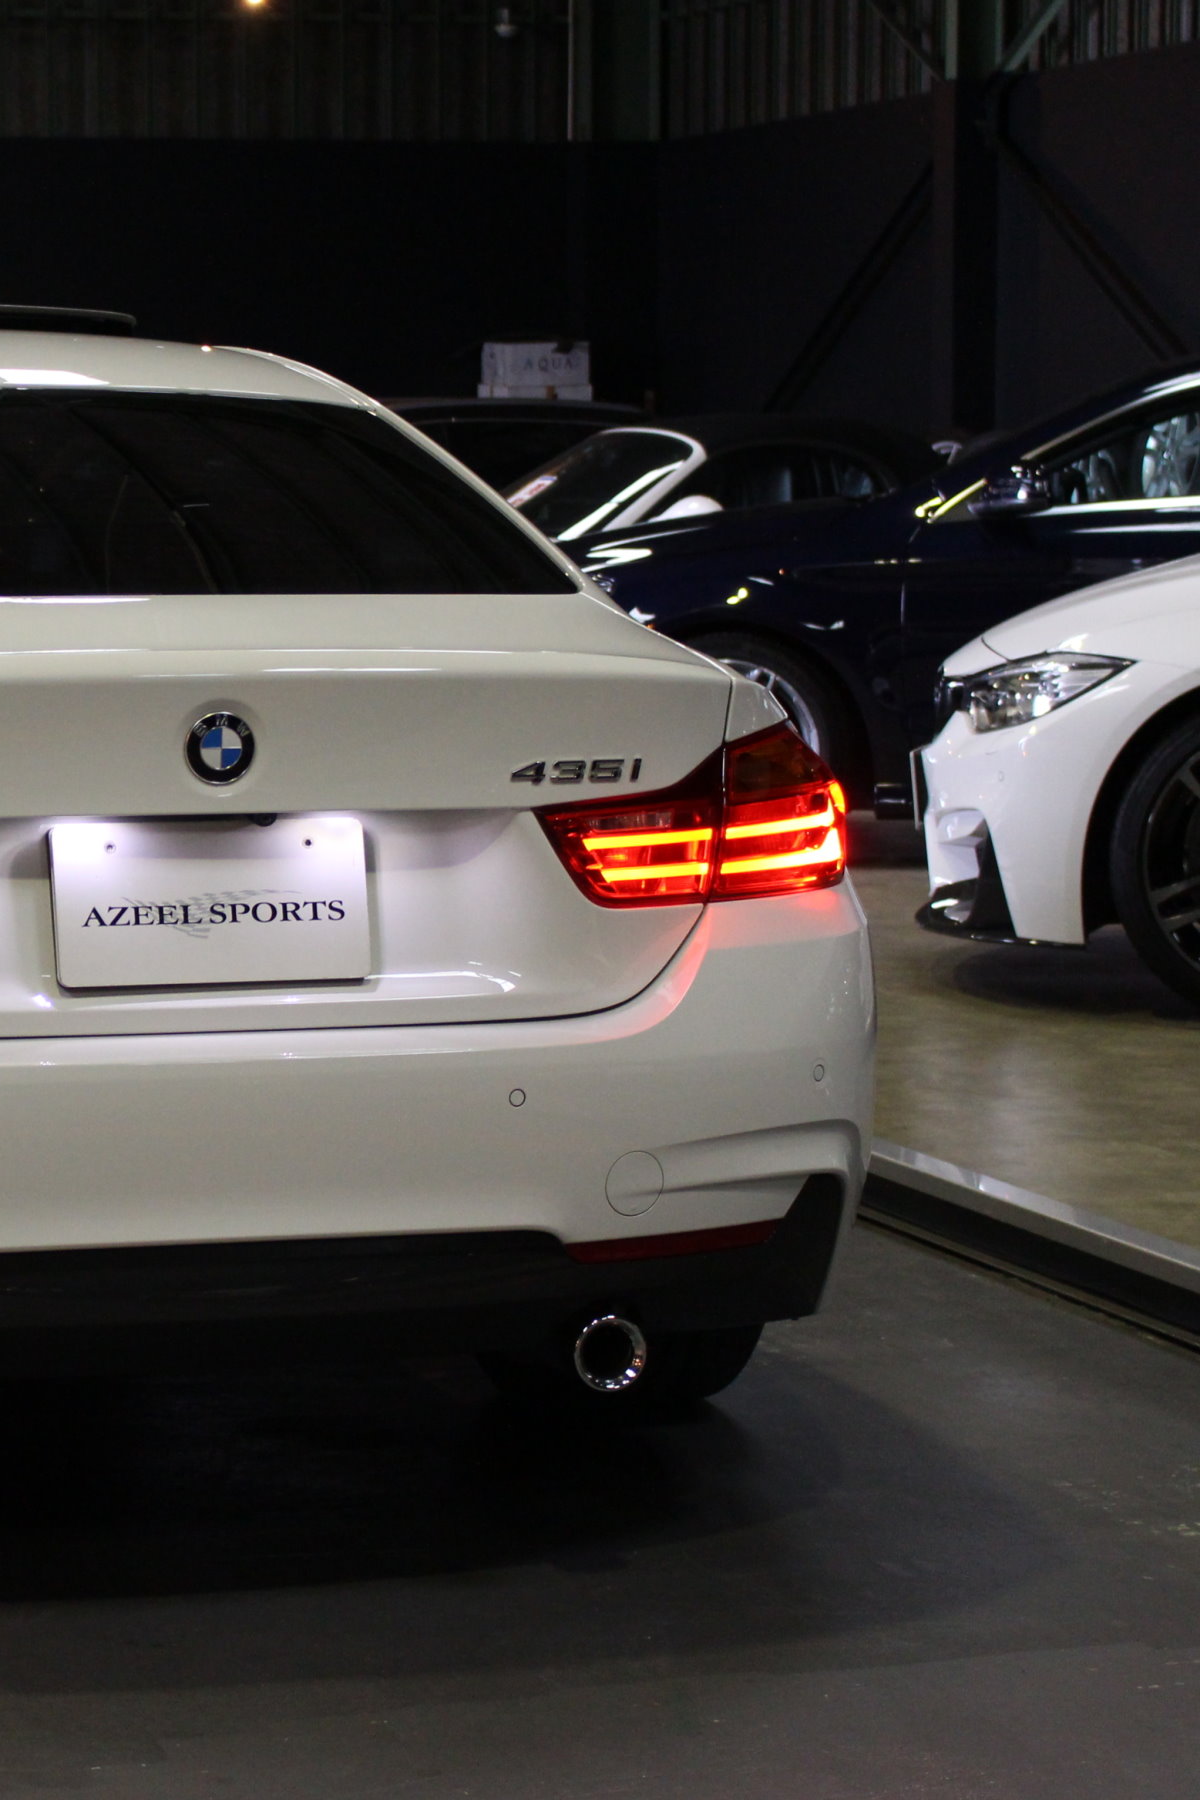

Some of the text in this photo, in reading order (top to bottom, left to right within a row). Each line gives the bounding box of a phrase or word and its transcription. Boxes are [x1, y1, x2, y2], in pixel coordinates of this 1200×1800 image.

[193, 713, 251, 738] BMW
[81, 899, 346, 928] AZEEL SPORTS
